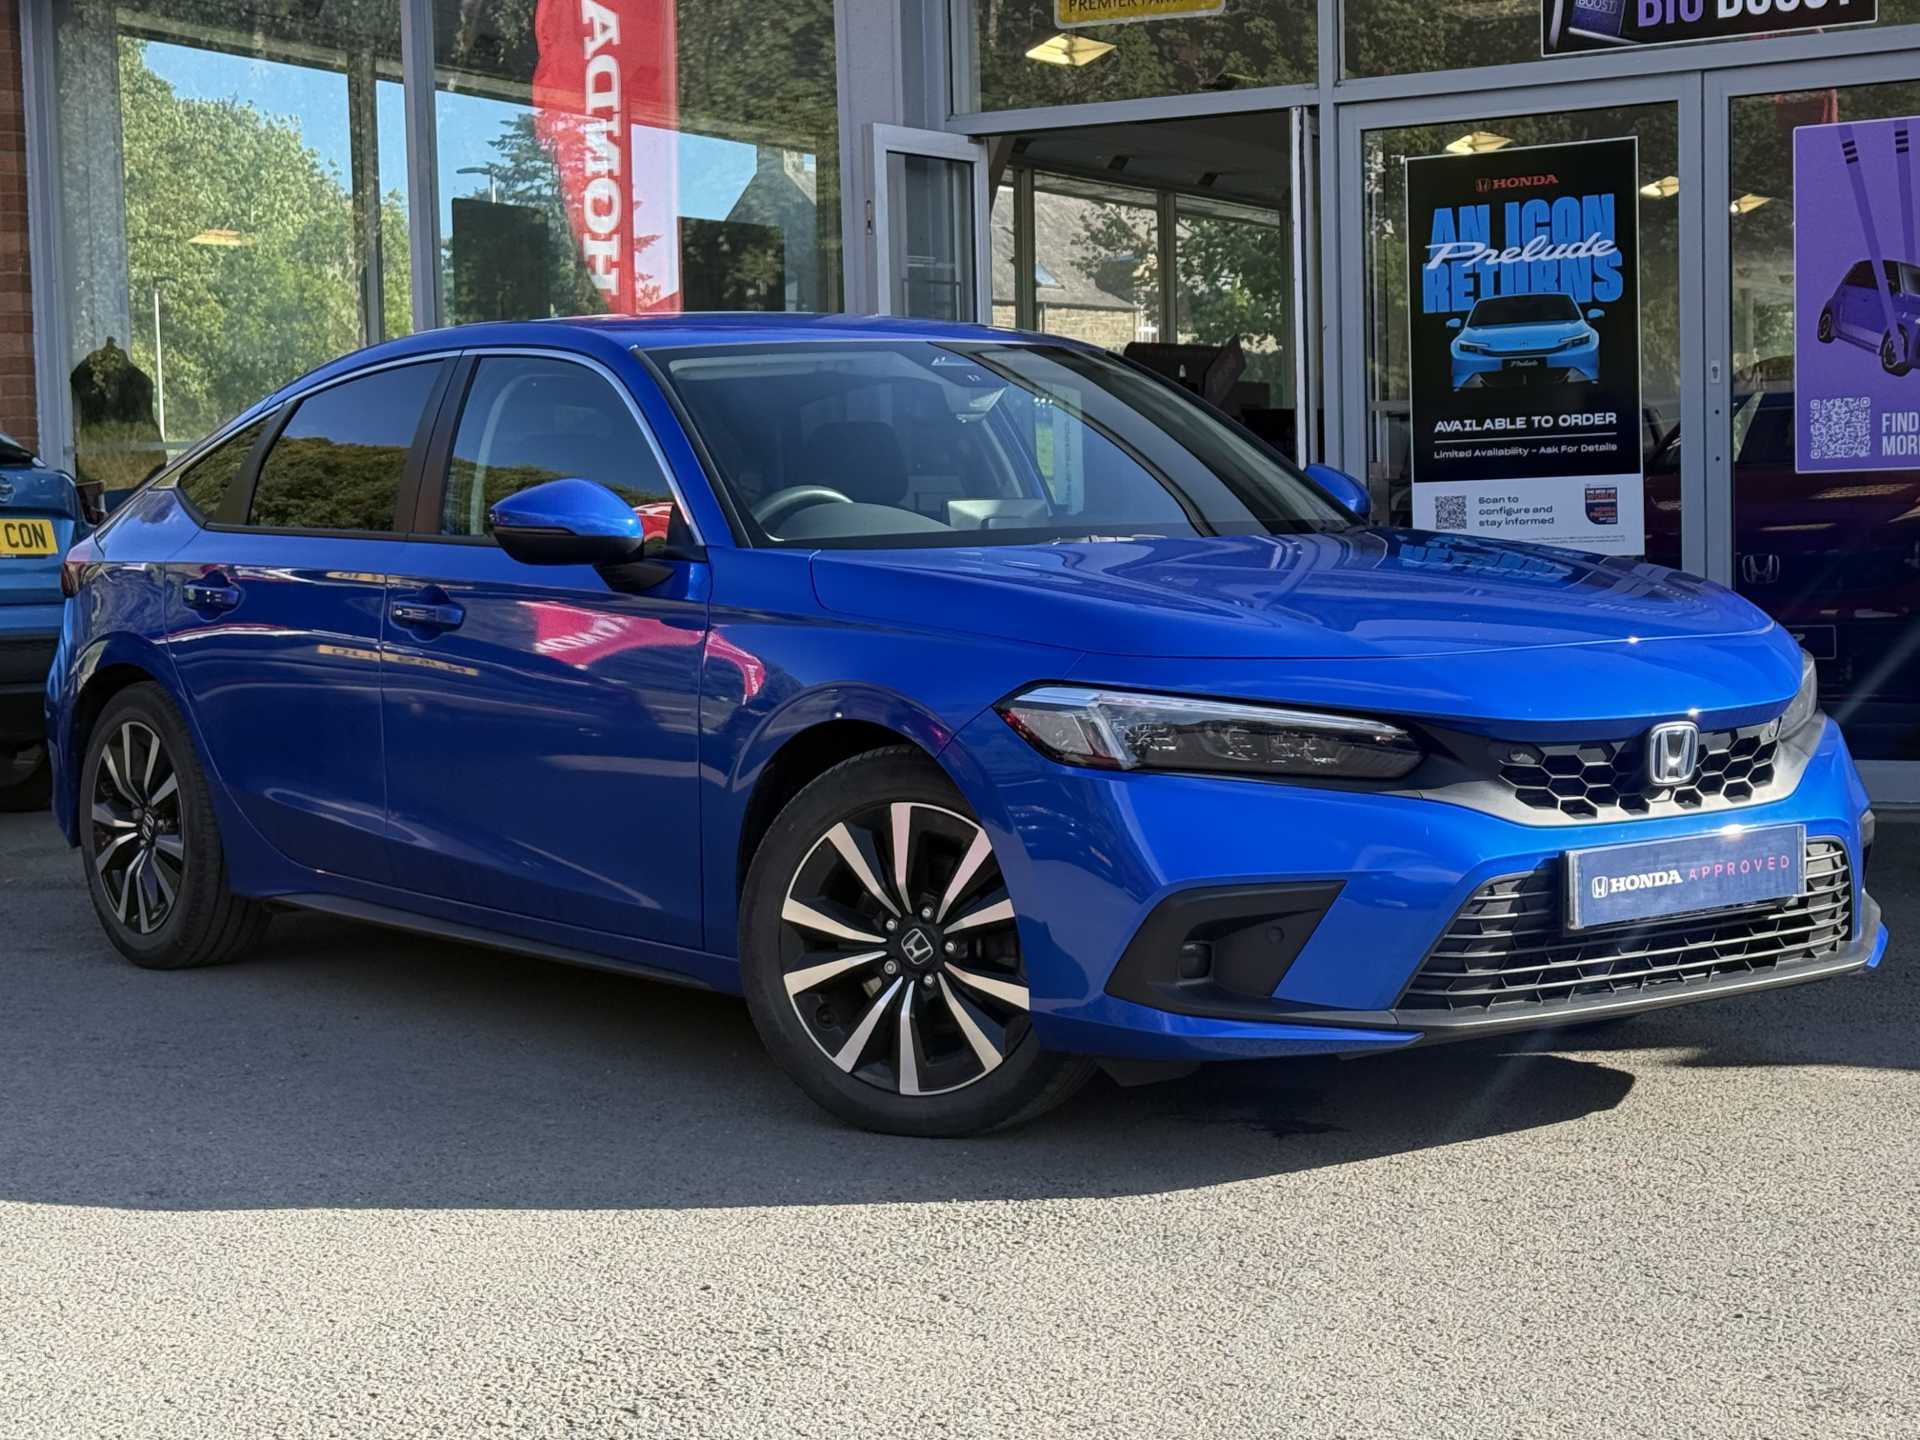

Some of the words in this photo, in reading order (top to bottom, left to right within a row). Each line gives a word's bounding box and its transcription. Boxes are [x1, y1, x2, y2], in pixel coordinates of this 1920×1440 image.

[1493, 175, 1559, 189] HONDA
[1431, 204, 1491, 259] AN
[1504, 193, 1616, 250] ICON
[1425, 232, 1618, 269] Prelude
[1423, 250, 1624, 314] RETURNS
[1434, 417, 1526, 433] AVAILABLE
[1531, 416, 1553, 428] TO
[1558, 412, 1617, 427] ORDER
[1882, 411, 1919, 433] FIND
[1434, 450, 1472, 459] Limited
[1474, 447, 1529, 457] Availability
[1539, 446, 1559, 454] Ask
[1561, 445, 1578, 453] For
[1581, 443, 1617, 452] Details
[1882, 434, 1920, 456] MOR
[1478, 496, 1506, 505] Scan
[1479, 506, 1530, 516] configure
[1532, 505, 1553, 514] and
[1479, 519, 1503, 528] stay
[1505, 517, 1554, 526] informed
[4, 523, 47, 548] CON
[1610, 870, 1683, 893] HONDA
[1689, 855, 1790, 881] APPROVED
